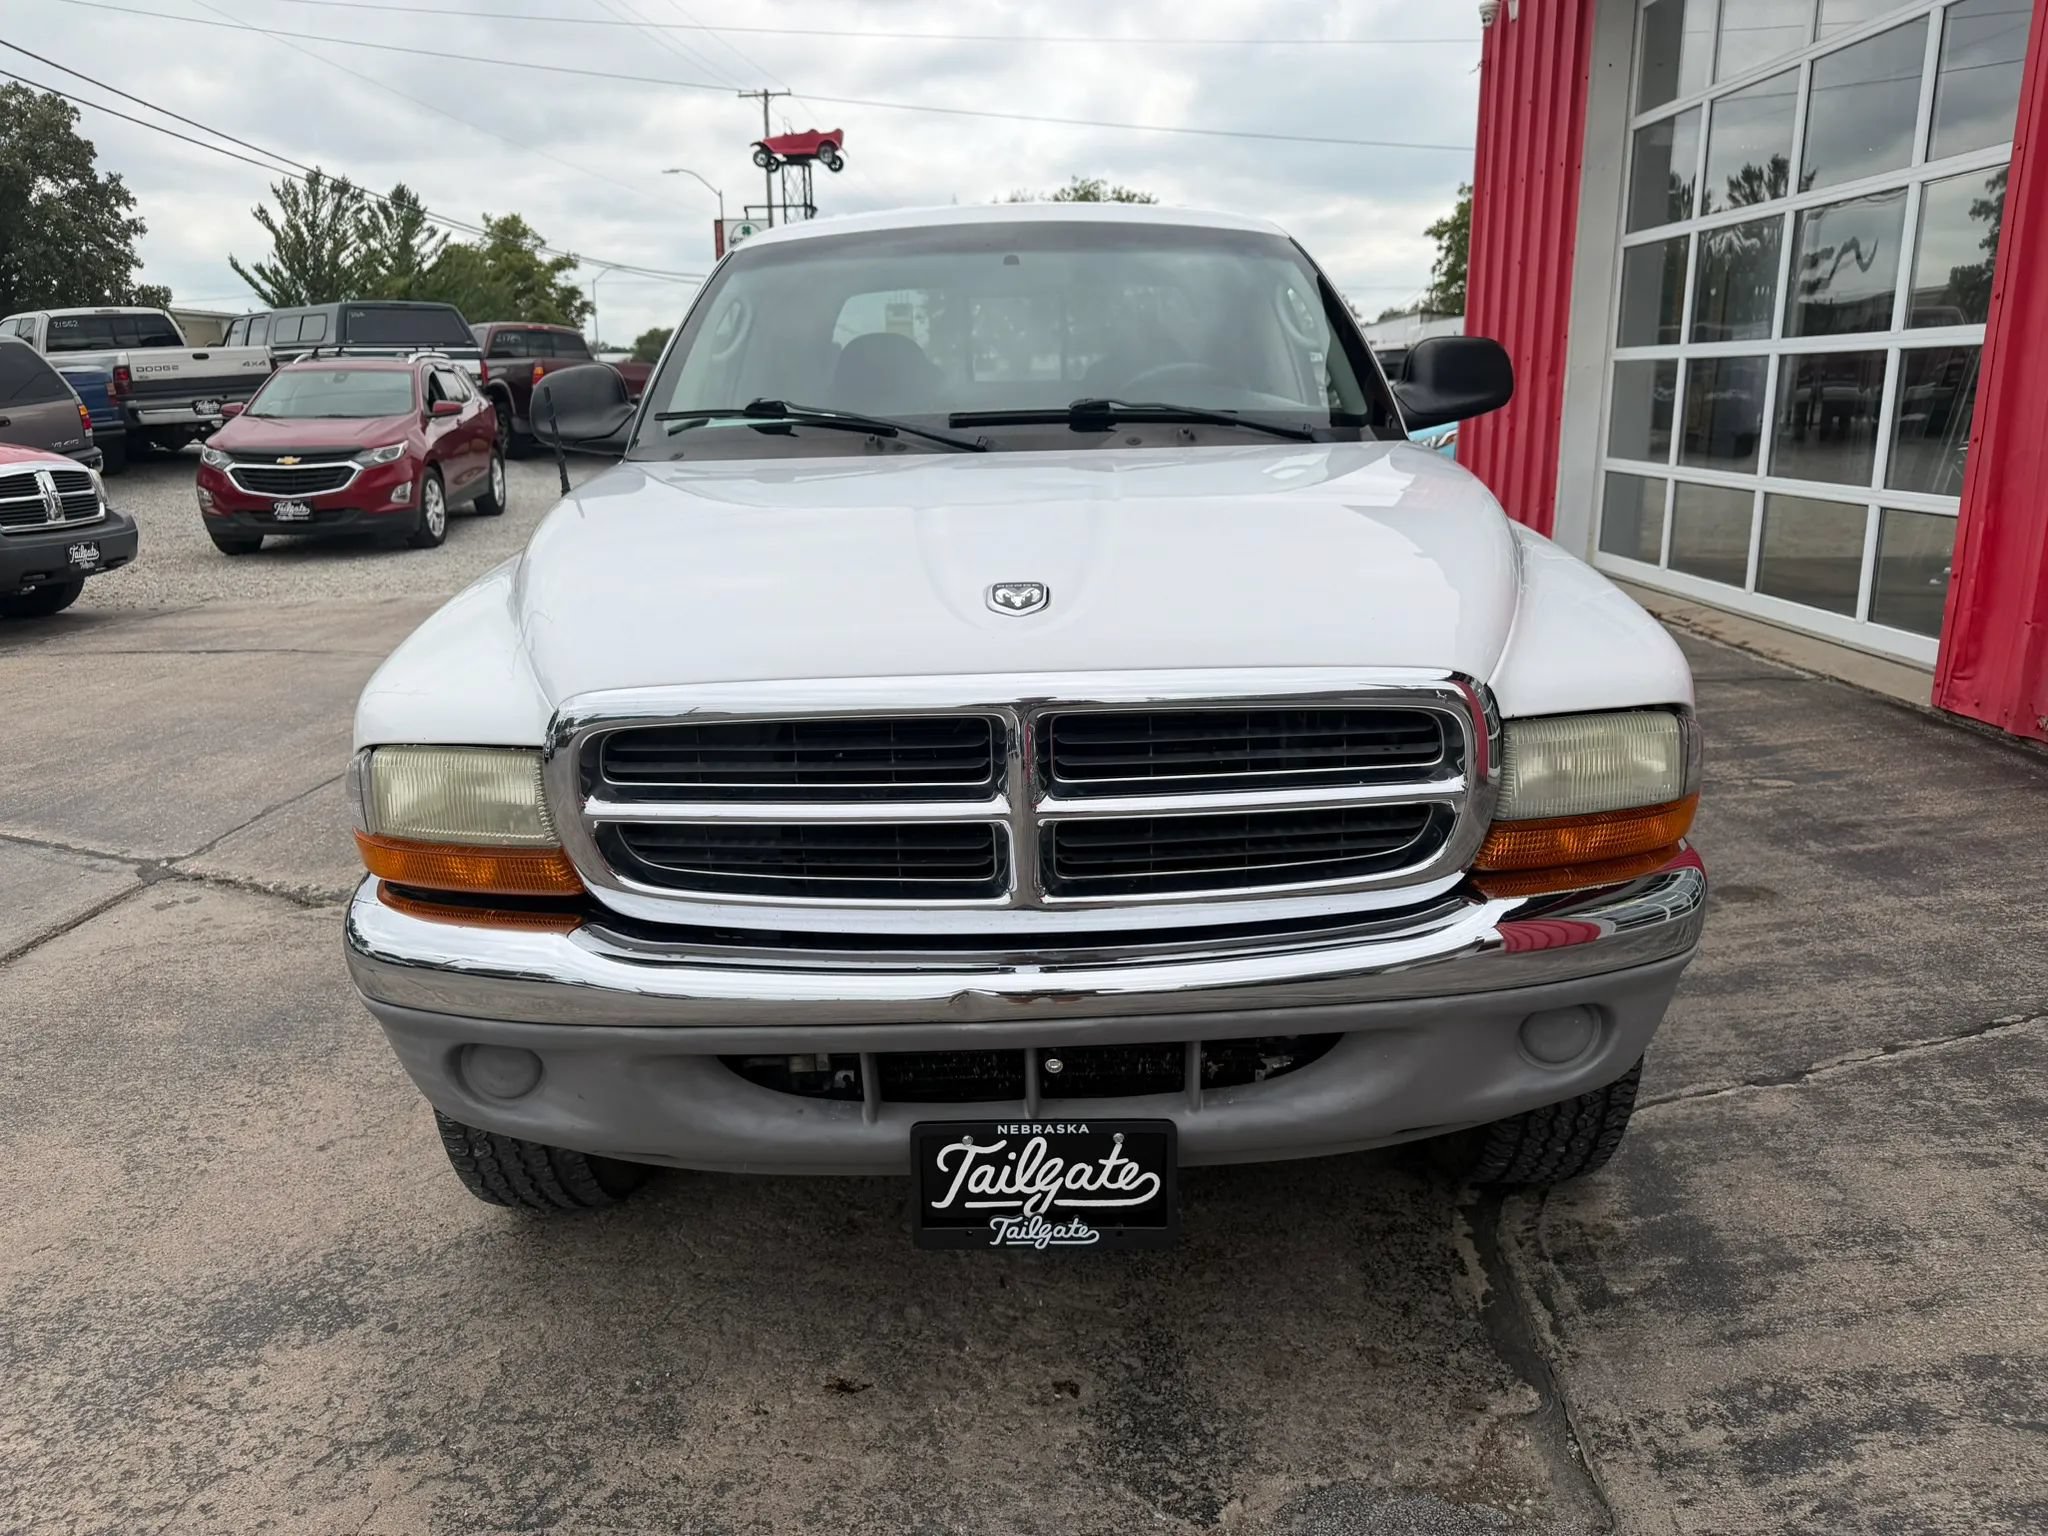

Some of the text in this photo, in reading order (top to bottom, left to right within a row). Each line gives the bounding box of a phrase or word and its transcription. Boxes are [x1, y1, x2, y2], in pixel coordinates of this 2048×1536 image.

[136, 365, 179, 373] DODGE
[997, 1124, 1090, 1135] NEBRASKA
[931, 1136, 1161, 1218] Tailgate
[989, 1215, 1100, 1249] Tailgate
